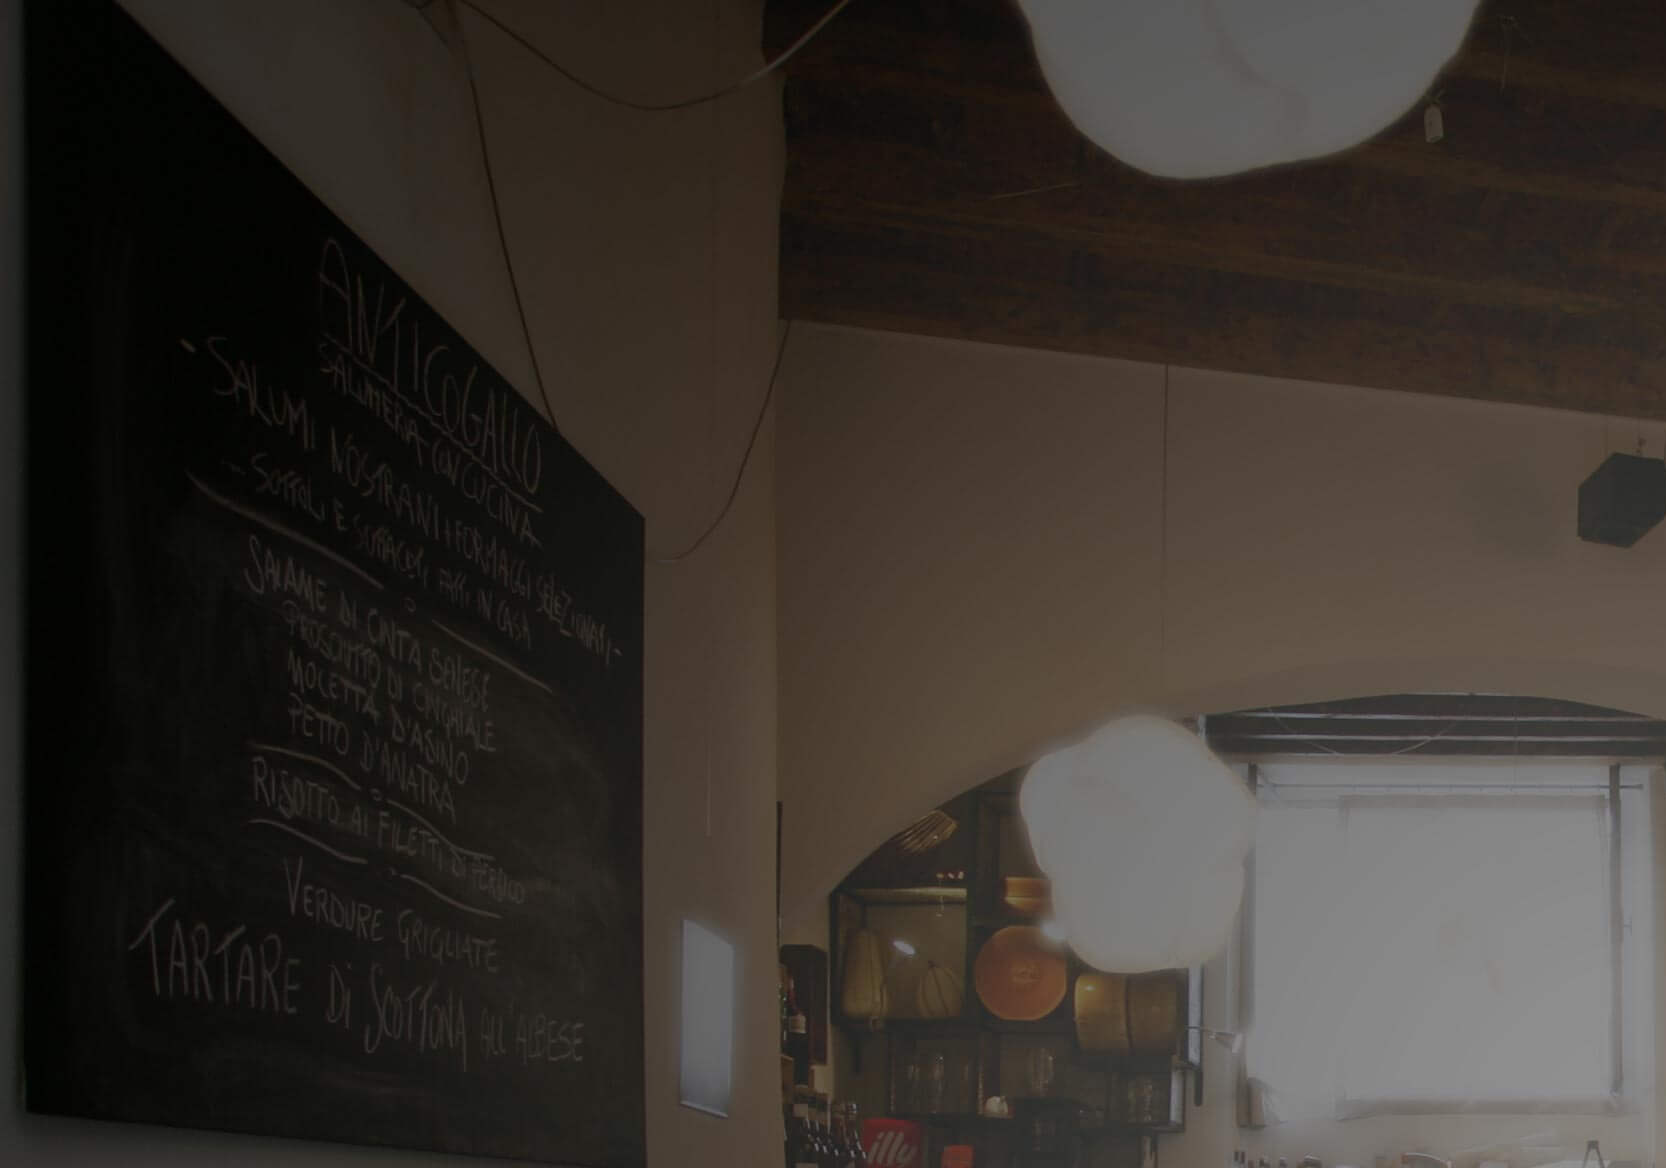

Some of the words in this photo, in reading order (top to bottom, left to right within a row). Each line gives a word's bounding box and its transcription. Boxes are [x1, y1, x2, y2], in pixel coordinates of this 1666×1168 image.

[206, 336, 317, 450] SALUMI
[329, 425, 440, 541] NOSTRANI
[461, 473, 544, 549] CUCINA
[243, 534, 328, 612] SALAME
[338, 590, 358, 632] DI
[287, 647, 382, 726] MOCETTA
[390, 704, 471, 787] D'ASINO
[386, 665, 403, 703] DI
[249, 755, 340, 827] RISOTTO
[350, 806, 371, 838] AI
[287, 692, 351, 757] PETTO
[360, 730, 458, 825] D'ANATRA
[283, 855, 385, 943] VERDURE
[399, 908, 499, 976] GRIGLIATE
[127, 897, 302, 1017] TARTARE
[362, 960, 468, 1074] SCOTTONA
